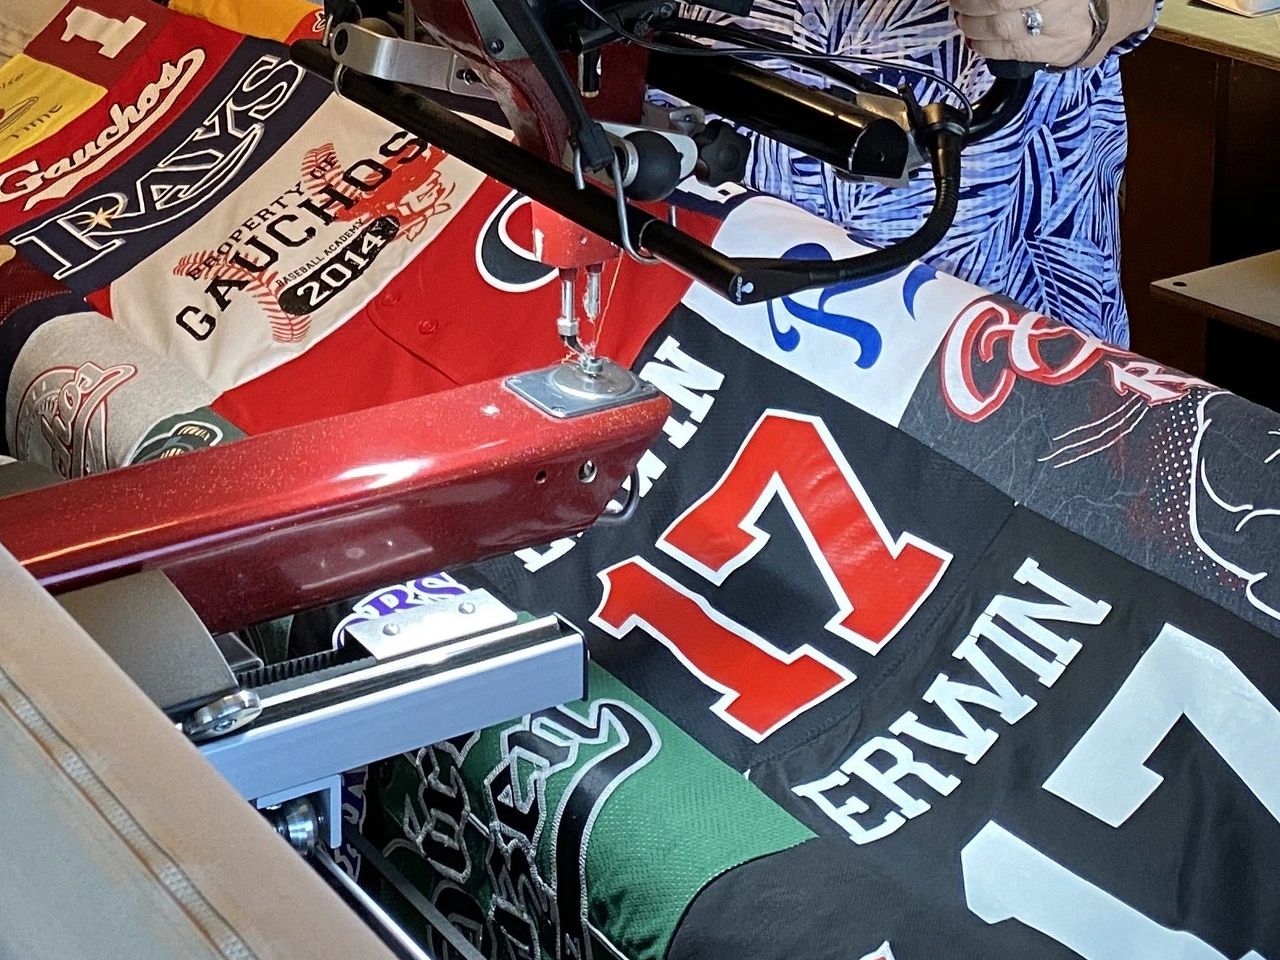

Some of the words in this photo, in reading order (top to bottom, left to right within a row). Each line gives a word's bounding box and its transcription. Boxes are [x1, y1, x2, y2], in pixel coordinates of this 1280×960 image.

[60, 4, 148, 59] 1
[9, 54, 308, 281] RAYS
[176, 131, 429, 341] GAUCHOS
[187, 181, 304, 281] PROPERTY
[310, 152, 338, 180] OF
[275, 256, 324, 287] BASEBALL
[323, 217, 366, 257] ACADEMY
[296, 230, 386, 308] 2014
[589, 407, 953, 744] 17
[791, 557, 1114, 846] ERWIN
[961, 622, 1280, 960] 17
